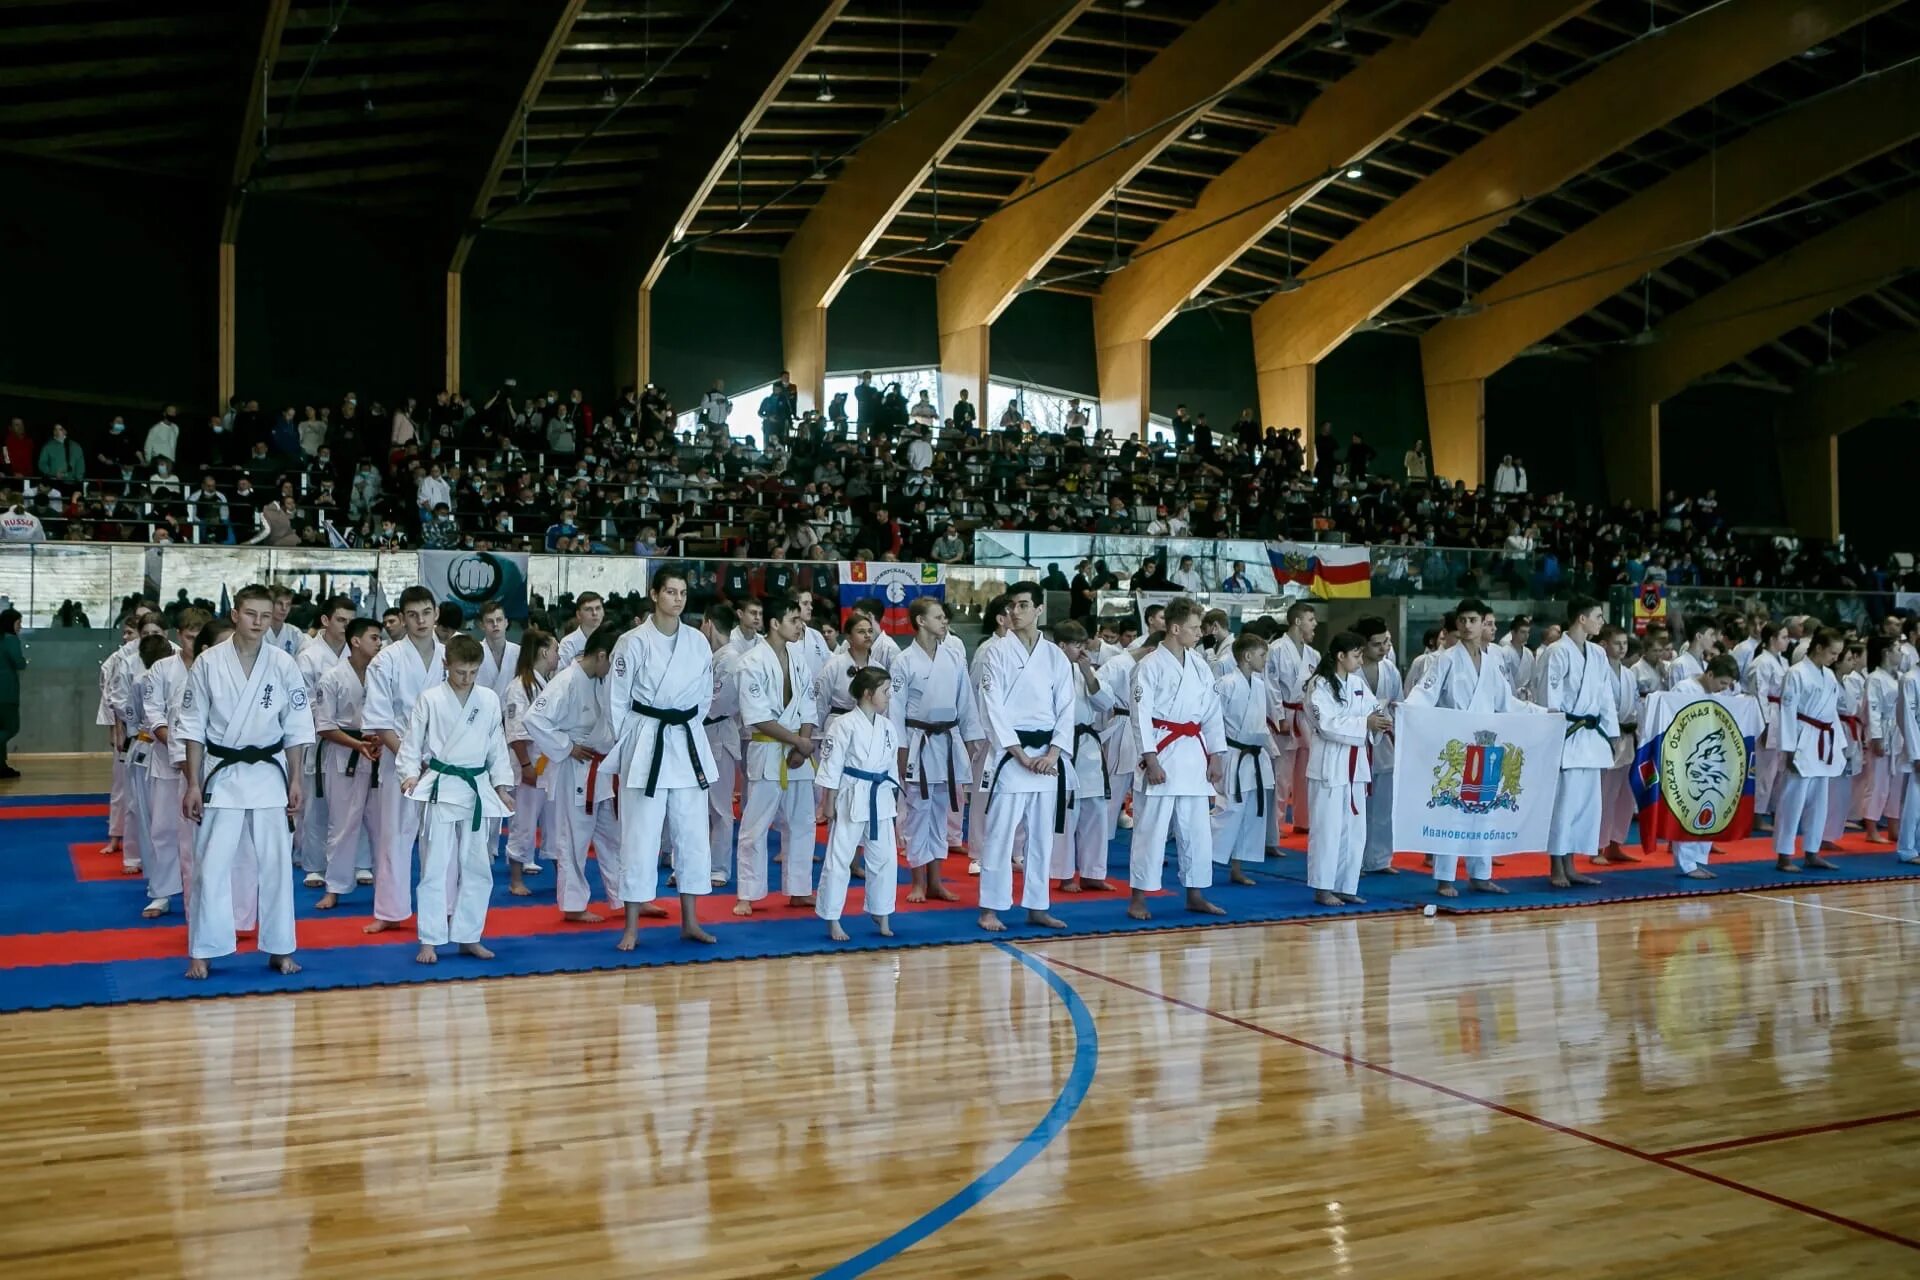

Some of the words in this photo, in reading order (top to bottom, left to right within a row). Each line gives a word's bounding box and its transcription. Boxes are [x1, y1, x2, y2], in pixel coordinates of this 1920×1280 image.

[4, 519, 33, 527] RUSSIA
[1670, 706, 1709, 749] ОБЛАСТНАЯ
[1422, 825, 1480, 840] Ивановская
